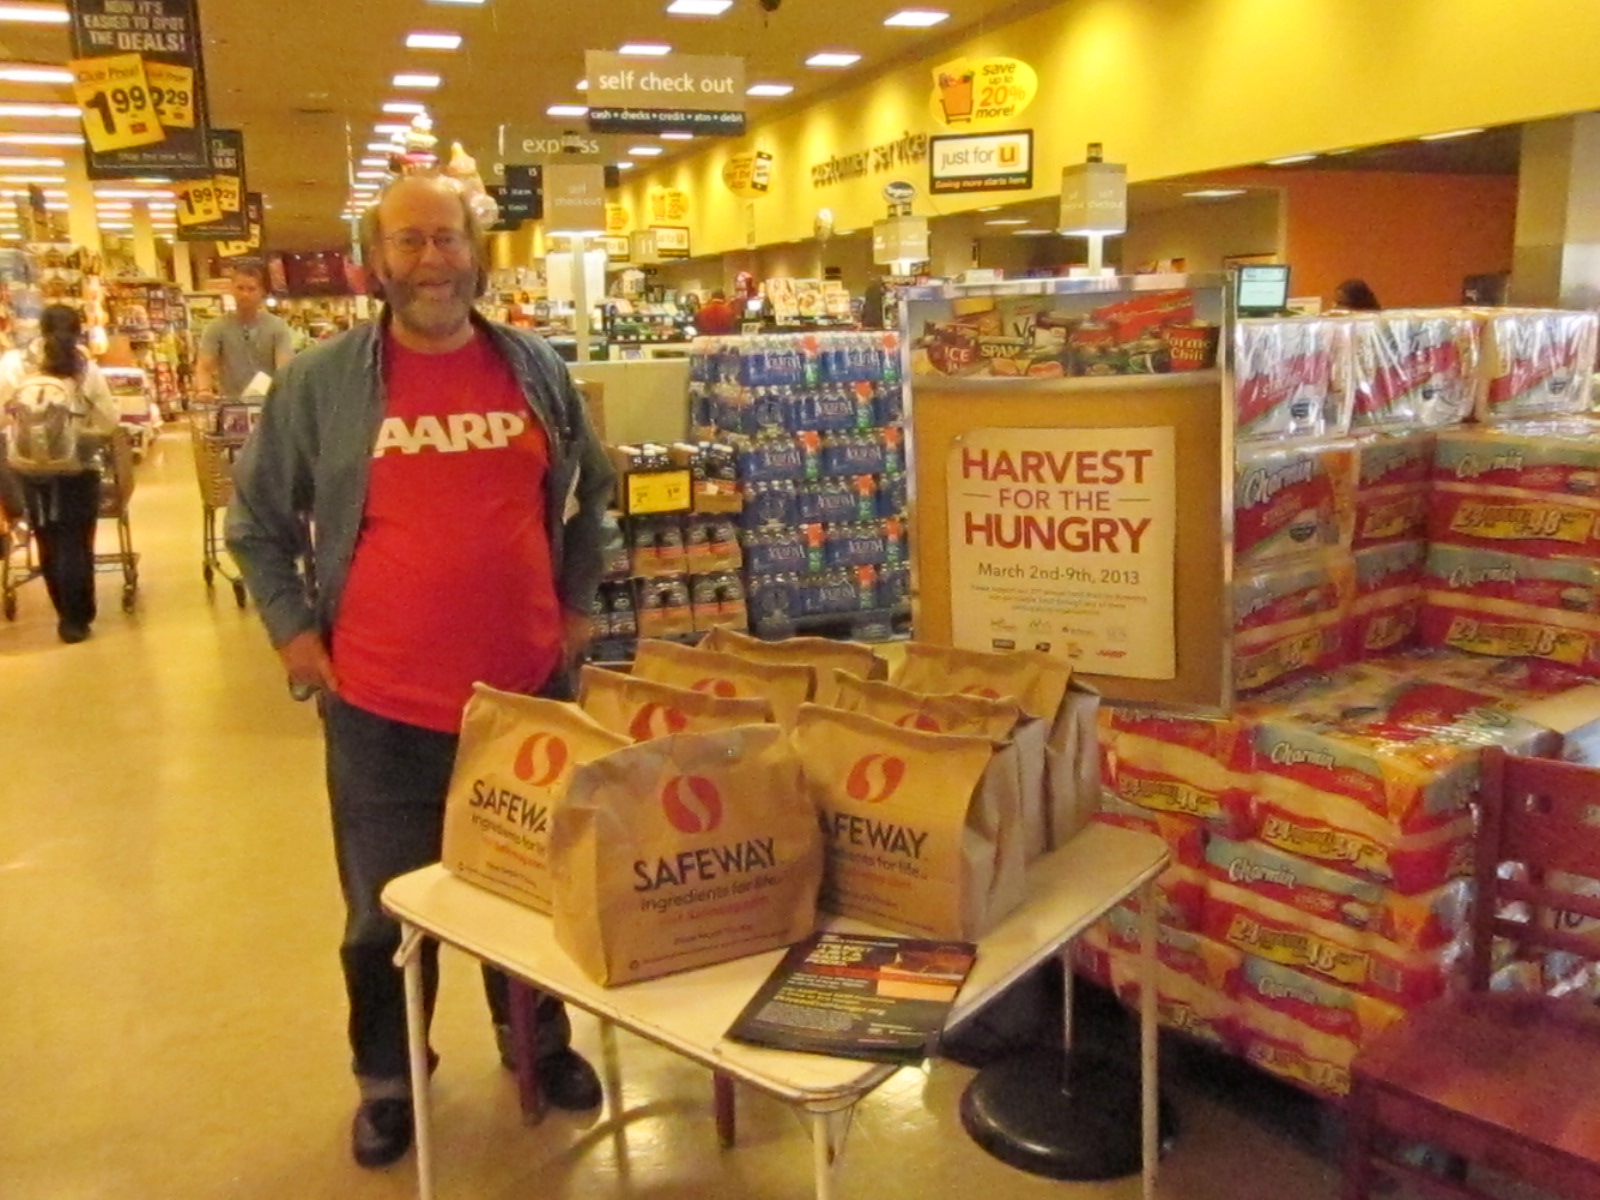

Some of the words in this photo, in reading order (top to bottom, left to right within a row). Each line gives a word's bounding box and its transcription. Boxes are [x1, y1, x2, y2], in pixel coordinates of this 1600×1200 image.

[117, 32, 186, 51] DEALS!
[982, 62, 1017, 76] save
[599, 71, 635, 90] self
[640, 72, 696, 93] check
[701, 76, 735, 94] out
[979, 85, 1027, 107] 20%
[591, 111, 612, 120] cash
[620, 112, 651, 121] checks
[720, 114, 744, 123] debit
[975, 104, 1015, 119] more!
[522, 138, 600, 155] expss
[941, 148, 970, 171] just
[973, 146, 995, 164] for
[980, 344, 1021, 359] SPAM
[373, 410, 525, 459] AARP
[962, 447, 1153, 486] HARVEST
[999, 487, 1051, 511] FOR
[1060, 489, 1111, 512] THE
[964, 511, 1152, 554] HUNGRY
[978, 562, 1025, 580] March
[1029, 564, 1097, 585] 2nd-9th,
[1101, 568, 1141, 585] 2013
[1270, 742, 1336, 772] Charmin
[633, 837, 777, 893] SAFEWAY
[1228, 858, 1298, 890] Charmin
[640, 884, 730, 914] ingredients
[732, 879, 753, 896] for
